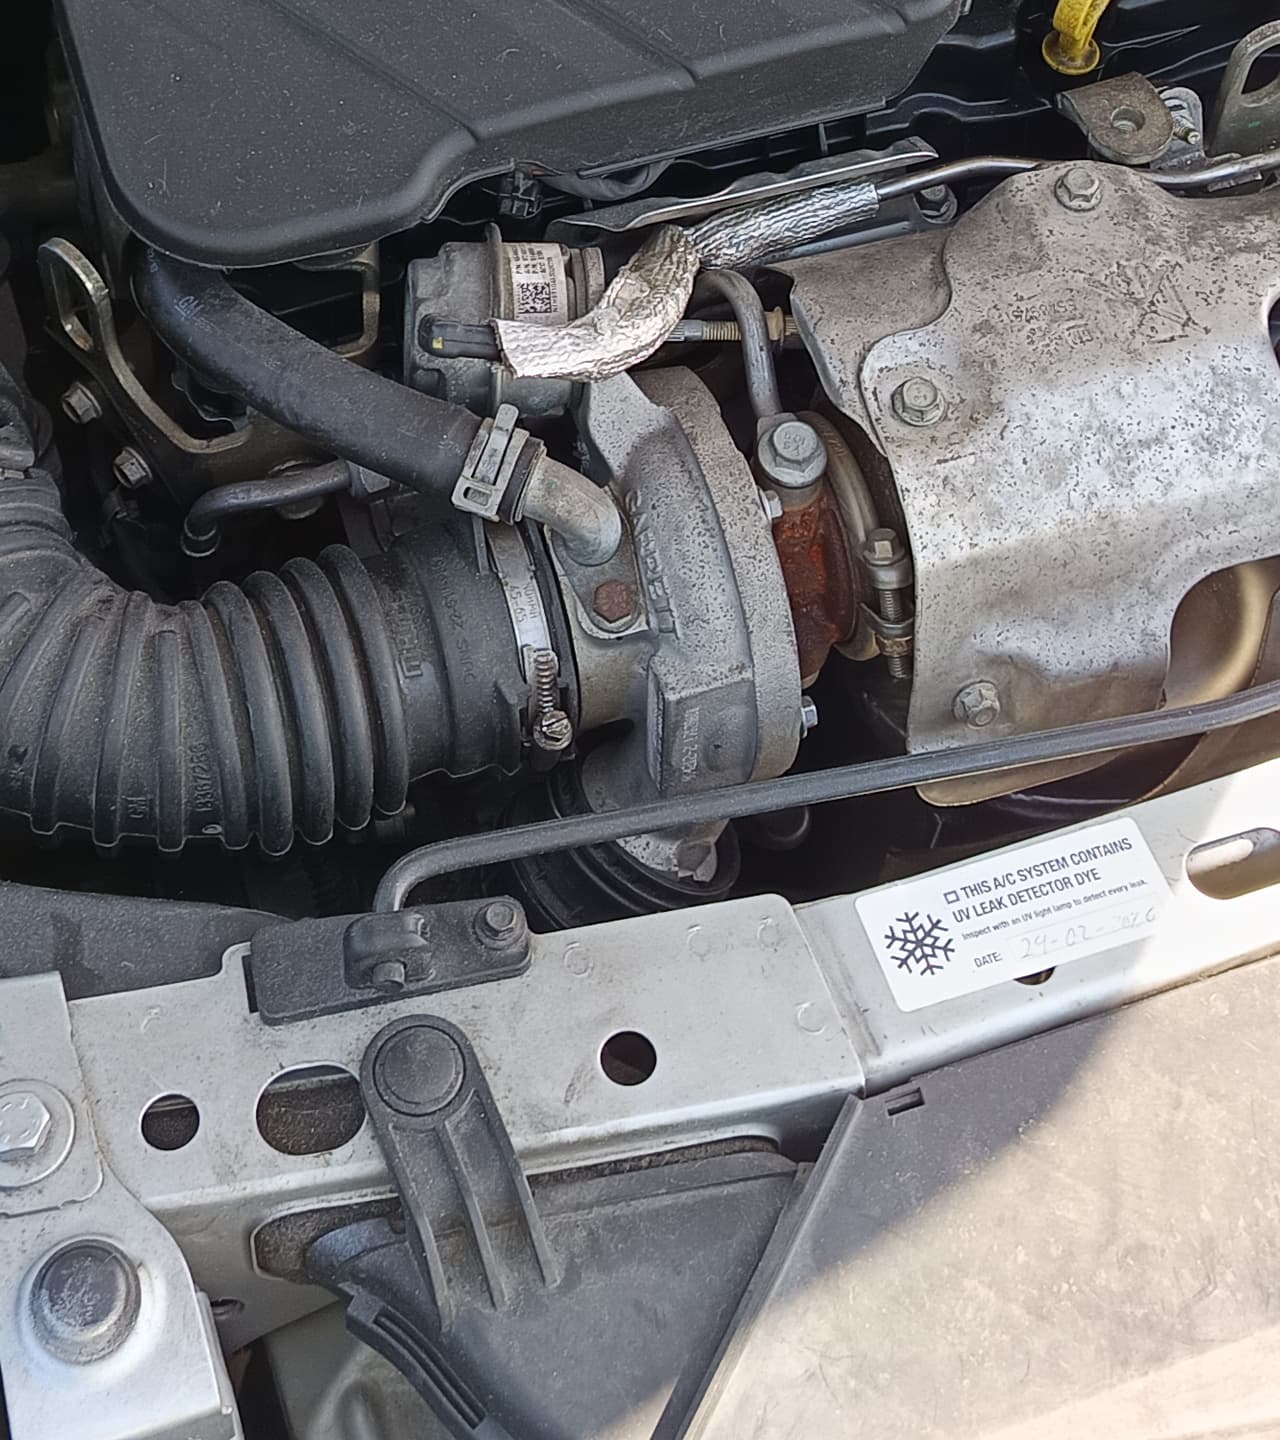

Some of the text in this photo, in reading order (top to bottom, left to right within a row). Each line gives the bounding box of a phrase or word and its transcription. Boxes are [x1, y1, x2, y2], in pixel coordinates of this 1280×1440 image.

[624, 489, 680, 640] GARRETT
[952, 867, 1102, 923] UV LEAK DETECTOR DYE
[960, 837, 1133, 899] THIS A/C SYSTEM CONTAINS
[962, 925, 992, 941] Inspect
[992, 920, 1010, 931] with
[1011, 917, 1021, 925] an
[1021, 913, 1033, 922] UV
[1033, 906, 1053, 919] light
[1052, 901, 1073, 913] lamp
[1083, 889, 1107, 903] detect
[1108, 885, 1128, 896] every
